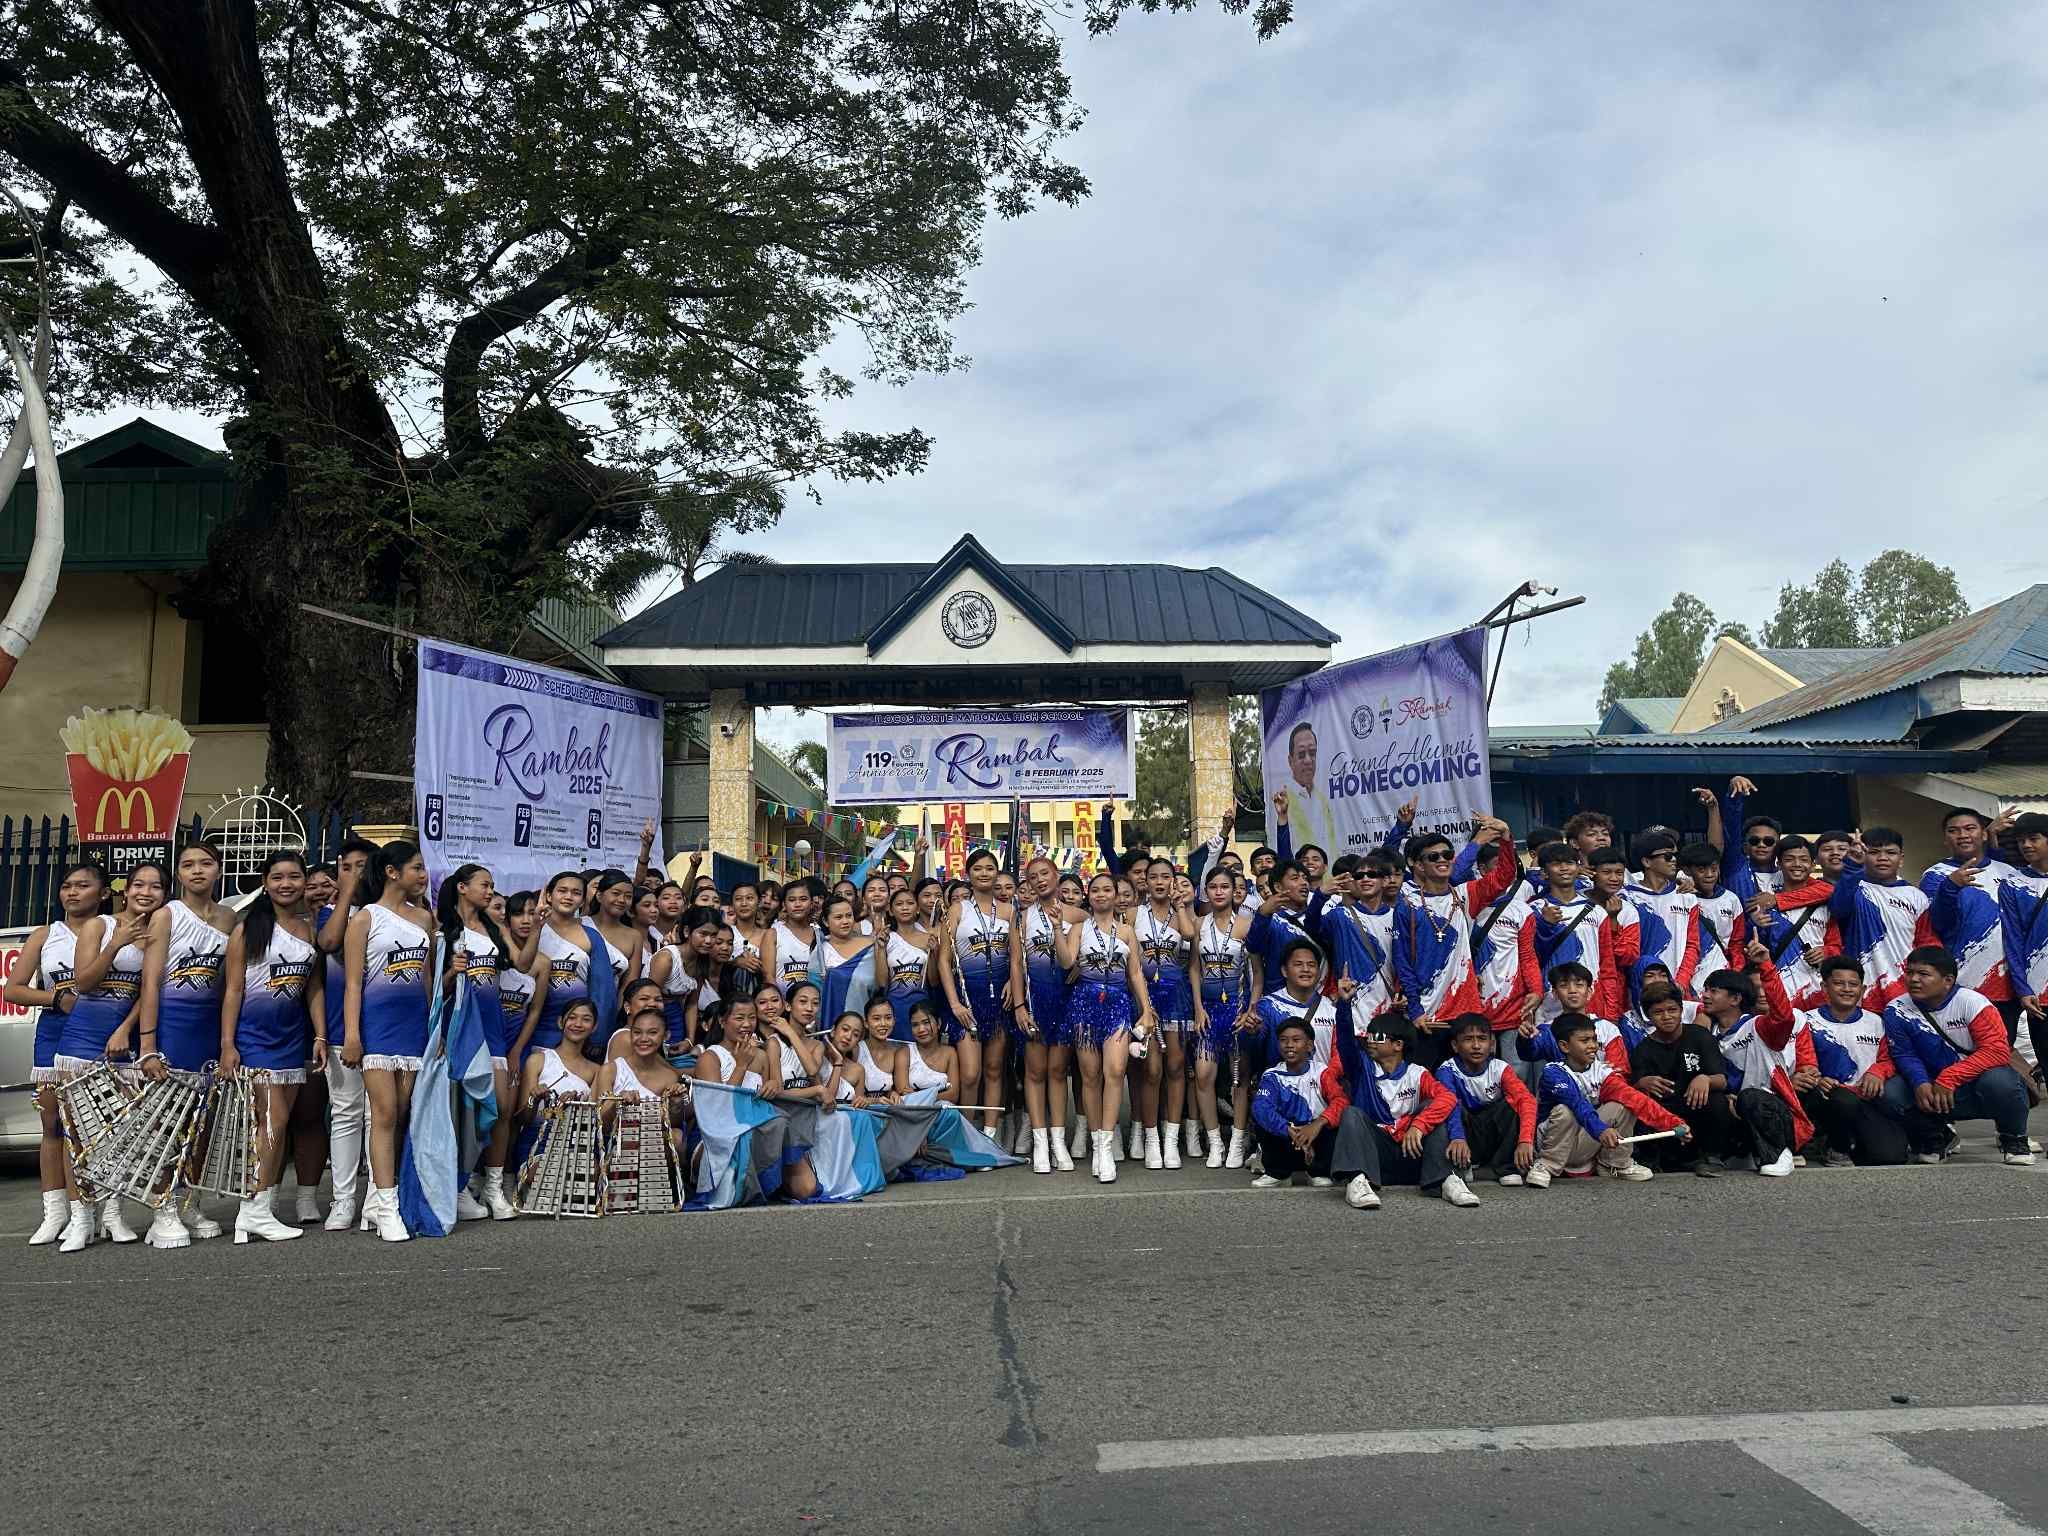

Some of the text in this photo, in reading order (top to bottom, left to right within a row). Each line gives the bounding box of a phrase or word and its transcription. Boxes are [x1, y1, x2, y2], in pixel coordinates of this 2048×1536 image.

[544, 679, 584, 699] SCHEDULE
[593, 690, 635, 711] ACTIVITIES
[874, 712, 1084, 724] ILOCOS NORTE NATIONAL HIGH SCHOOL
[484, 703, 613, 801] Rambak
[1329, 733, 1478, 777] Grand Alumni
[935, 733, 1064, 790] Rambak
[849, 766, 931, 784] Anniversary
[1014, 768, 1104, 778] 6-8 FEBRUARY 2025
[1328, 753, 1482, 800] HOMECOMING
[568, 775, 603, 795] 2025
[428, 798, 442, 810] FEB
[517, 807, 531, 818] FEB
[428, 811, 440, 837] 6
[518, 820, 528, 842] 7
[87, 831, 167, 841] Bacarra Road
[589, 824, 599, 846] 8
[1348, 833, 1371, 846] HON.
[113, 847, 165, 859] DRIVE
[393, 949, 425, 961] INNHS
[552, 962, 574, 971] NHS
